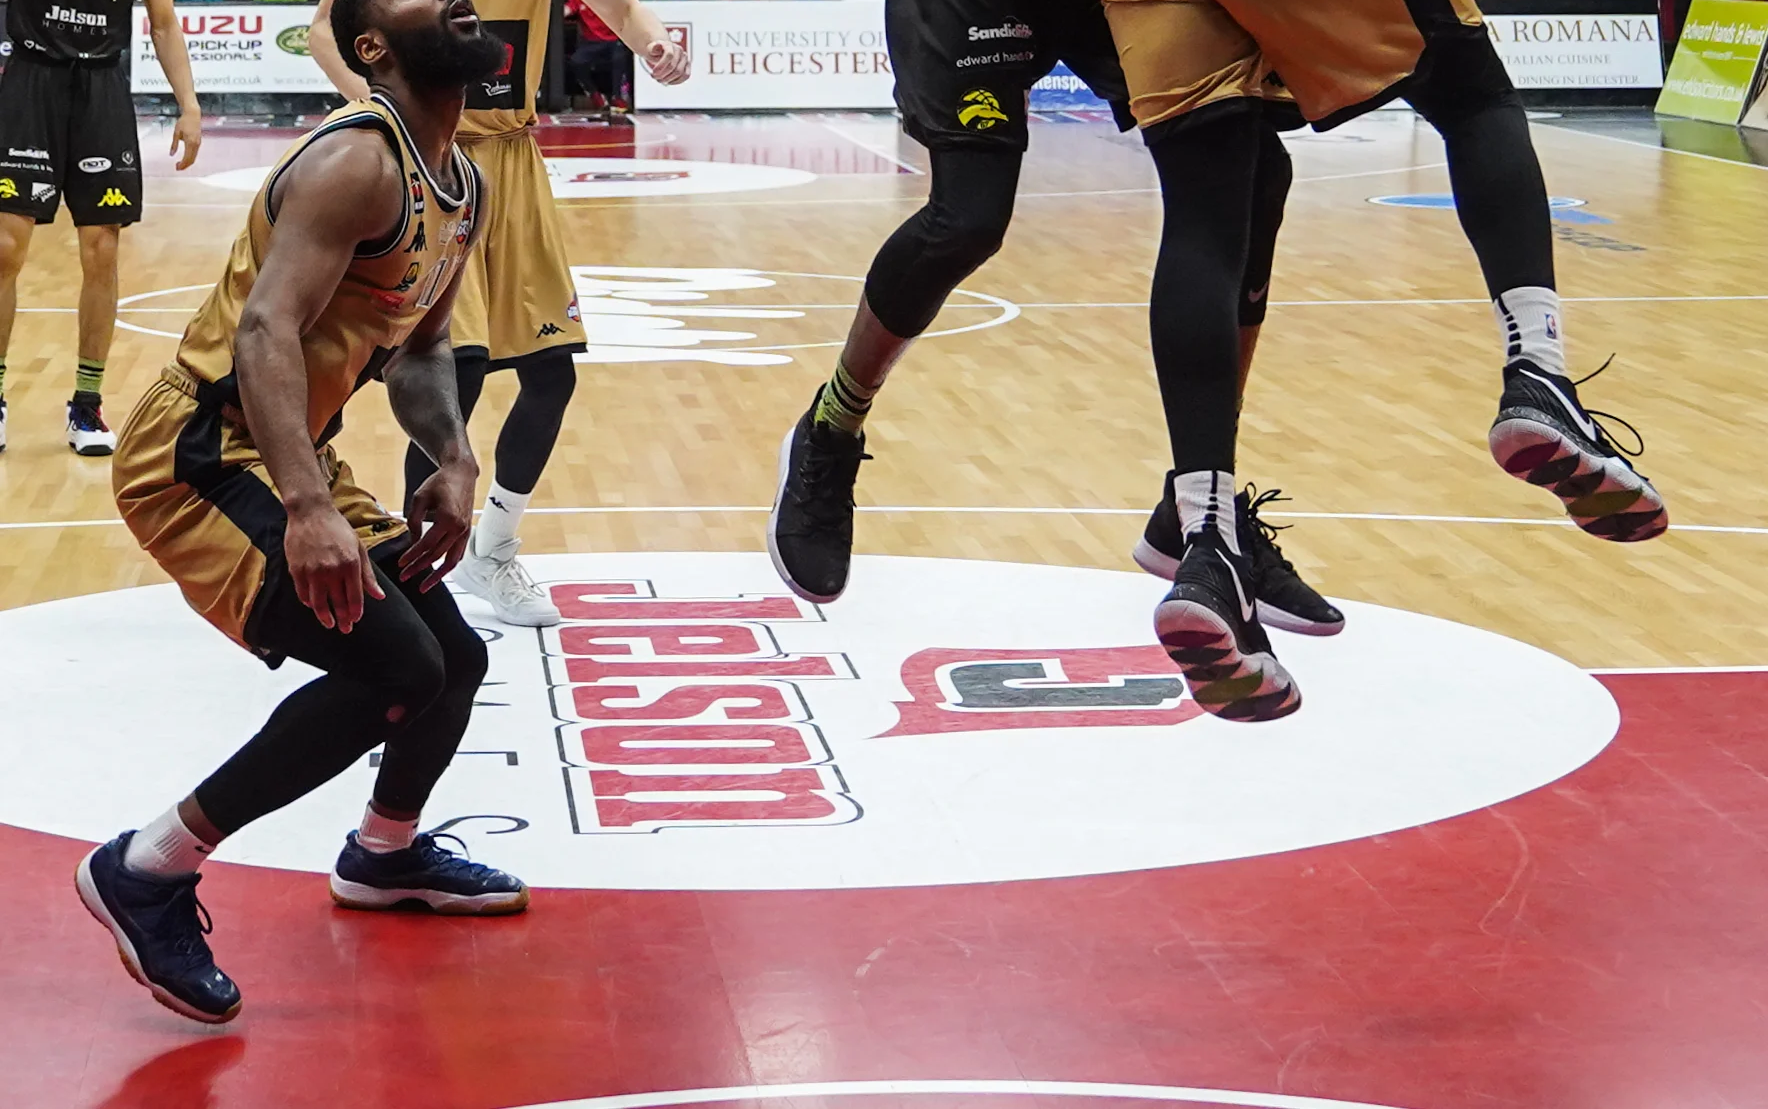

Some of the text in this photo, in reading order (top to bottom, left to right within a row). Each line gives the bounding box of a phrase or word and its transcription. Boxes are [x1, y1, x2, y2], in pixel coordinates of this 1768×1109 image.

[45, 5, 108, 27] Jelson
[143, 16, 263, 35] IUZU
[1512, 19, 1656, 43] ROMANA
[188, 40, 262, 51] PICK-UP
[707, 31, 848, 48] UNIVERSITY
[141, 52, 262, 62] PRSSIONALS
[708, 51, 892, 75] LEICESTER
[956, 53, 1000, 68] edward
[1501, 54, 1612, 65] TALIAN CUISINE
[1517, 75, 1640, 85] DINING IN LEICESTER
[540, 579, 856, 833] Jelson
